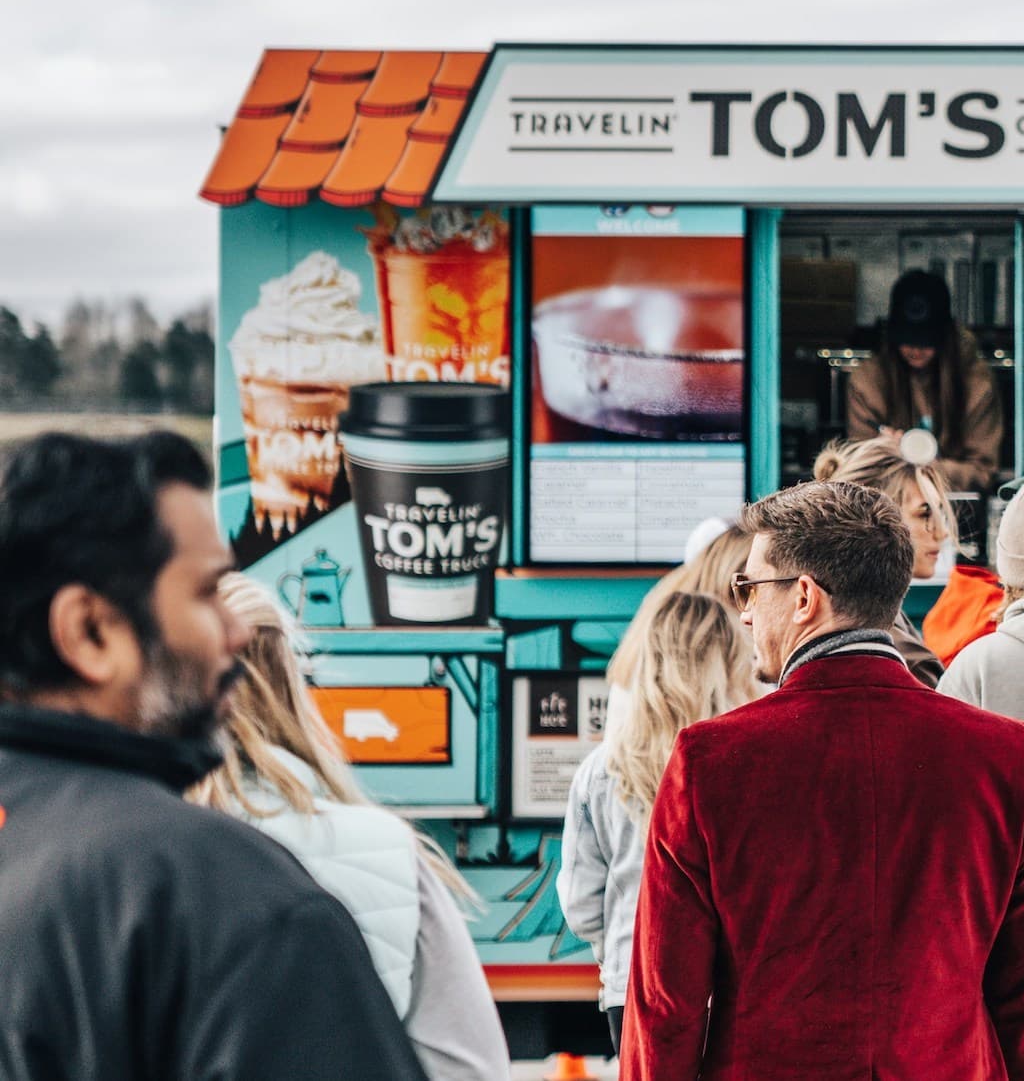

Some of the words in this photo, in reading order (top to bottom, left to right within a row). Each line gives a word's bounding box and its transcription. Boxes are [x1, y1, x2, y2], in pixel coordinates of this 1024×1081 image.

[689, 90, 1006, 159] TOM'S
[597, 219, 682, 234] WELCOME
[364, 514, 499, 558] TOM'S
[374, 551, 433, 575] COFFEE
[441, 552, 489, 575] TRUCK
